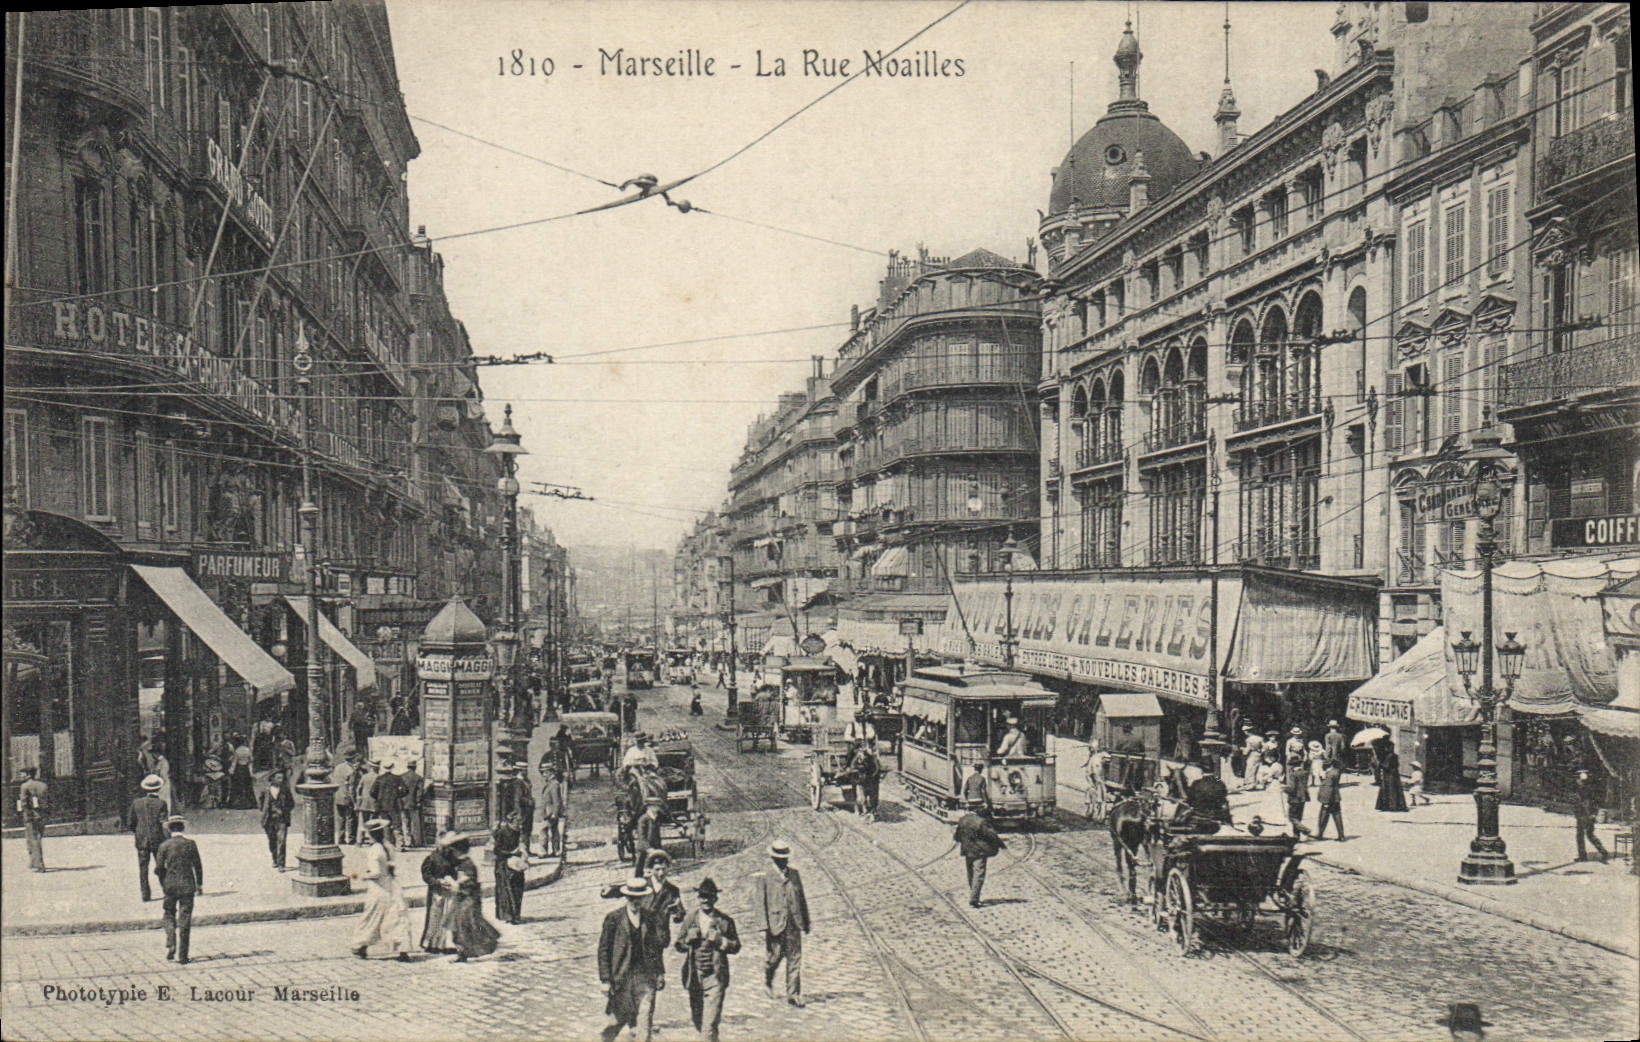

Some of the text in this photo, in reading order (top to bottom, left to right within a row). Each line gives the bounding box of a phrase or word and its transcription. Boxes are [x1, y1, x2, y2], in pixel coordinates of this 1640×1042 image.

[1585, 517, 1640, 544] COIFF
[198, 553, 281, 578] PARFUMEUR
[1065, 592, 1213, 661] GALERIES
[418, 659, 450, 673] MAGGI
[455, 660, 492, 673] MAGGI
[1079, 658, 1137, 683] NOUVELLES
[1140, 667, 1200, 696] GALERIES
